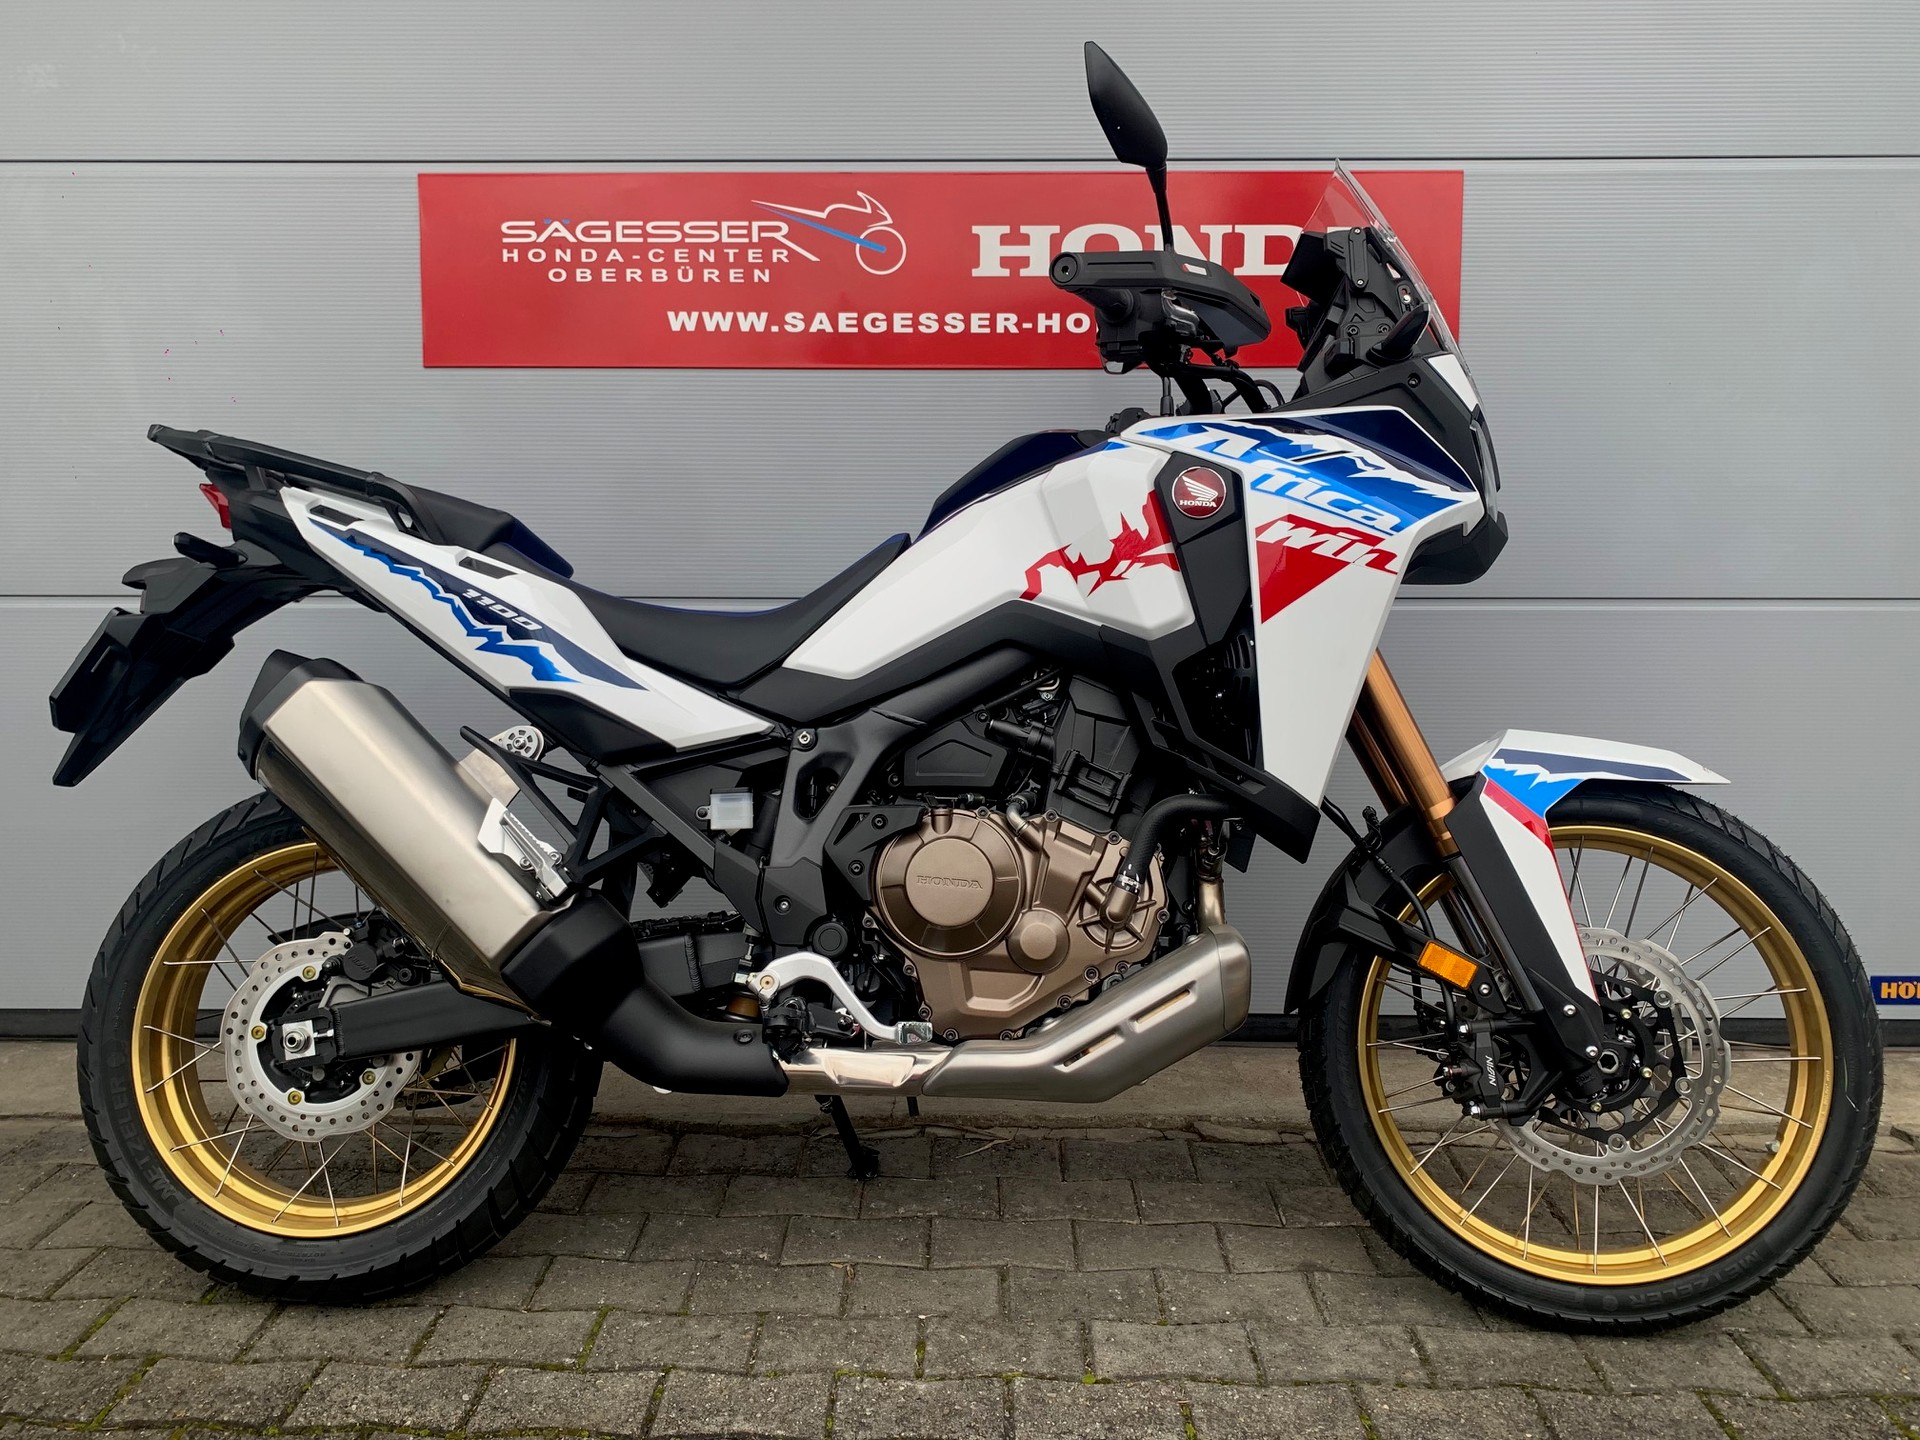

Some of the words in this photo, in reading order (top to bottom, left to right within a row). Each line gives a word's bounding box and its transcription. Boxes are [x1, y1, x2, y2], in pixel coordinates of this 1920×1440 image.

[500, 218, 820, 262] SÄGESSER
[502, 249, 790, 263] HONDA-CENTER
[971, 223, 1352, 277] HOND
[548, 265, 771, 283] OBERBÜREN
[667, 311, 1099, 334] WWW.SAEGESSER-HO
[1180, 500, 1218, 508] HONDA
[462, 588, 543, 631] 1100
[916, 875, 984, 890] HONDA
[1881, 981, 1920, 999] HÖ
